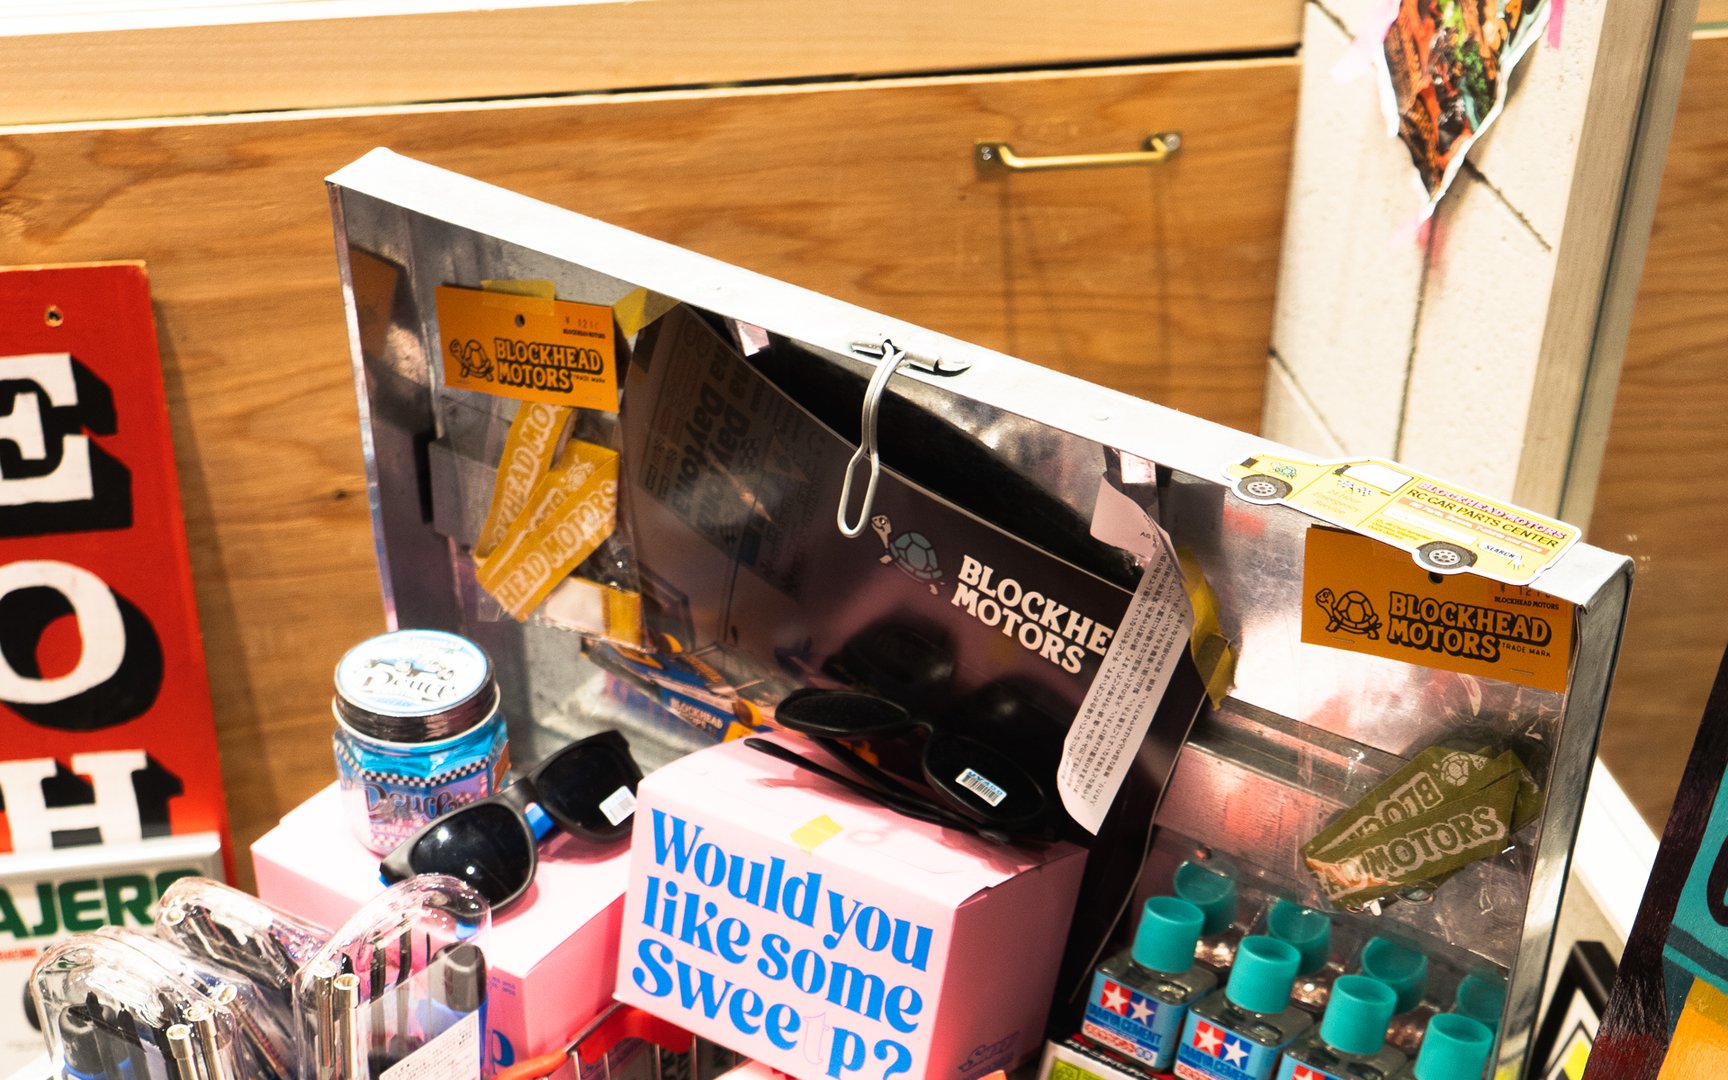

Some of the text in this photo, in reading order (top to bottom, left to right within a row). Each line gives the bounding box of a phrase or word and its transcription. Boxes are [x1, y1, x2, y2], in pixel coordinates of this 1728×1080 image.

[494, 338, 604, 375] BLOCKHEAD
[497, 364, 573, 393] MOTORS
[1406, 488, 1427, 501] RC
[1427, 497, 1457, 512] CAR
[1456, 506, 1501, 527] PARTS
[1501, 522, 1560, 548] CENTER
[1417, 481, 1505, 519] BLOCKHEAD
[1503, 511, 1568, 540] MOTORS
[951, 582, 1087, 675] MOTORS
[957, 554, 1115, 657] BLOCKHE
[1389, 591, 1552, 647] BLOCKHEAD
[1494, 595, 1559, 611] BLOCKHEAD MOTORS
[1387, 616, 1551, 663] MOTORS TRADE MARK
[363, 783, 459, 825] Deuce
[1366, 805, 1508, 880] MOTORS
[651, 807, 934, 972] Would you
[641, 875, 923, 1034] like some
[1121, 1017, 1162, 1046] CEMENT
